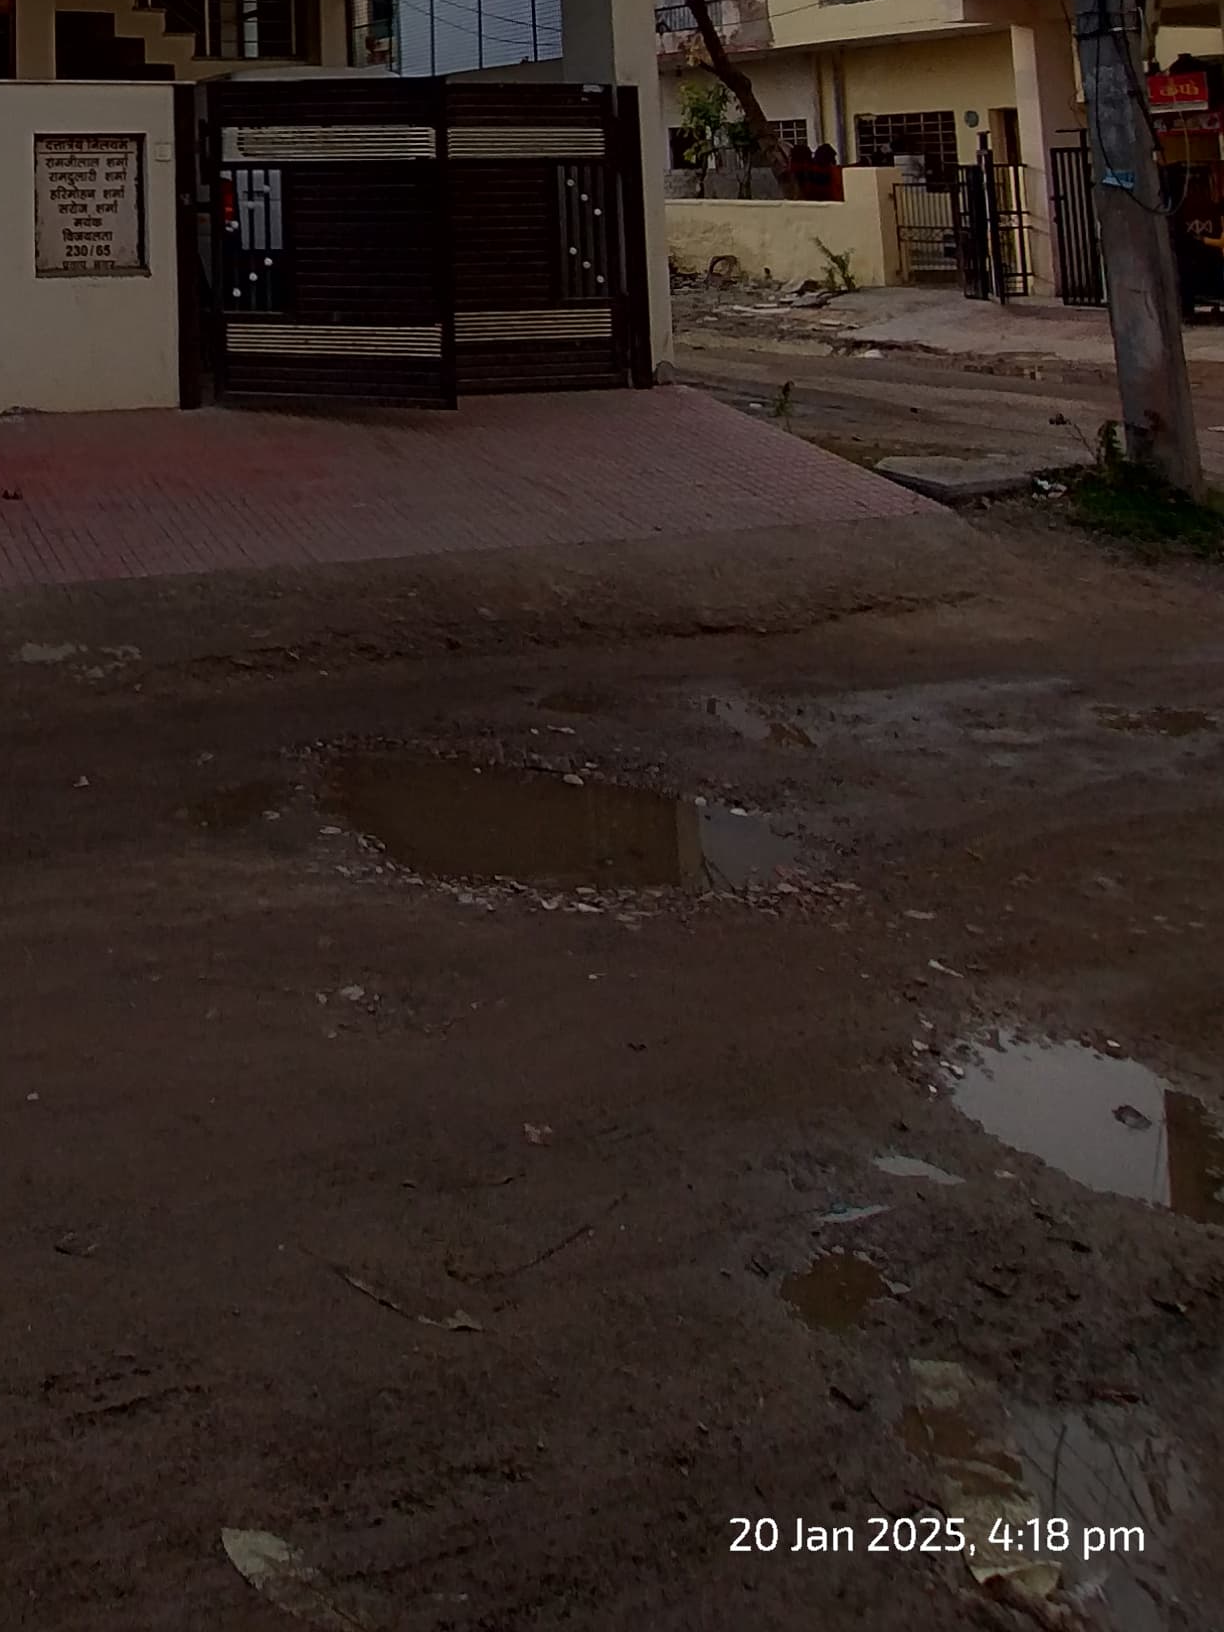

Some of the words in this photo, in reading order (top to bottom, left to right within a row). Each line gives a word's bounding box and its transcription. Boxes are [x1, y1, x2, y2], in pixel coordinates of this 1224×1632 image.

[106, 153, 129, 168] शर्मा
[48, 168, 97, 185] रामदुलारी
[105, 169, 127, 181] शर्मा
[49, 185, 96, 200] हरिमोहन
[103, 185, 125, 199] शर्मा
[58, 201, 88, 214] सरोज
[96, 200, 119, 214] शर्मा
